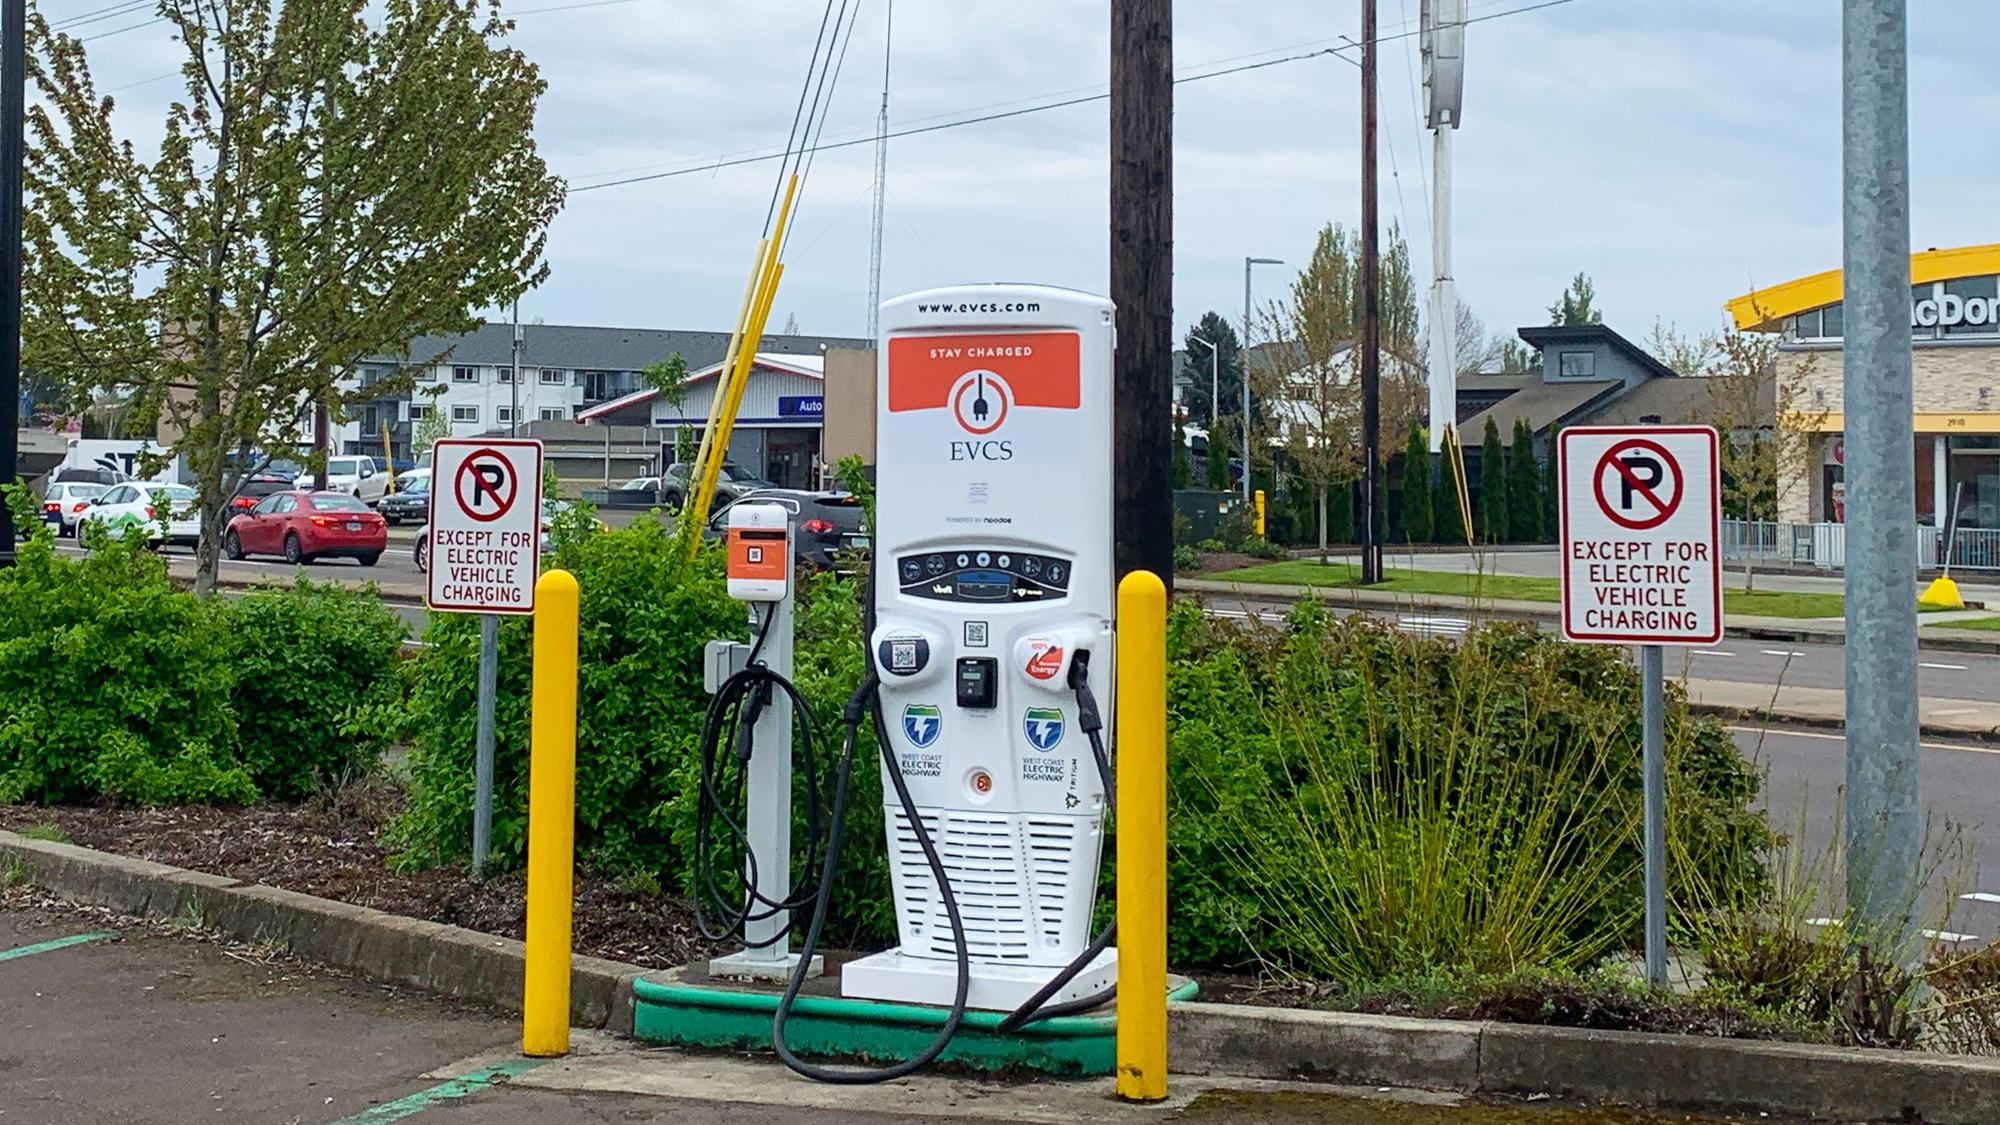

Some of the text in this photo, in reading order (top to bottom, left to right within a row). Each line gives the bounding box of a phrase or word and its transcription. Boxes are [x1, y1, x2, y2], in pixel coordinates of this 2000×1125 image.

[918, 302, 1040, 313] www.evcs.com
[930, 346, 1032, 359] STAY CHARGED
[799, 400, 823, 411] Auto
[949, 440, 1013, 461] EVCS
[437, 530, 531, 548] EXCEPT FOR
[448, 549, 518, 566] ELECTRIC
[1573, 541, 1708, 562] EXCEPT FOR
[450, 567, 515, 584] VEHICLE
[1590, 564, 1691, 584] ELECTRIC
[442, 585, 521, 603] CHARGING
[1595, 587, 1687, 607] VEHICLE
[1586, 609, 1697, 631] CHARGING
[902, 760, 942, 769] ELECTRIC
[902, 769, 942, 777] HIGHWAY
[1023, 764, 1064, 774] ELECTRIC
[1023, 773, 1064, 781] HIGHWAY
